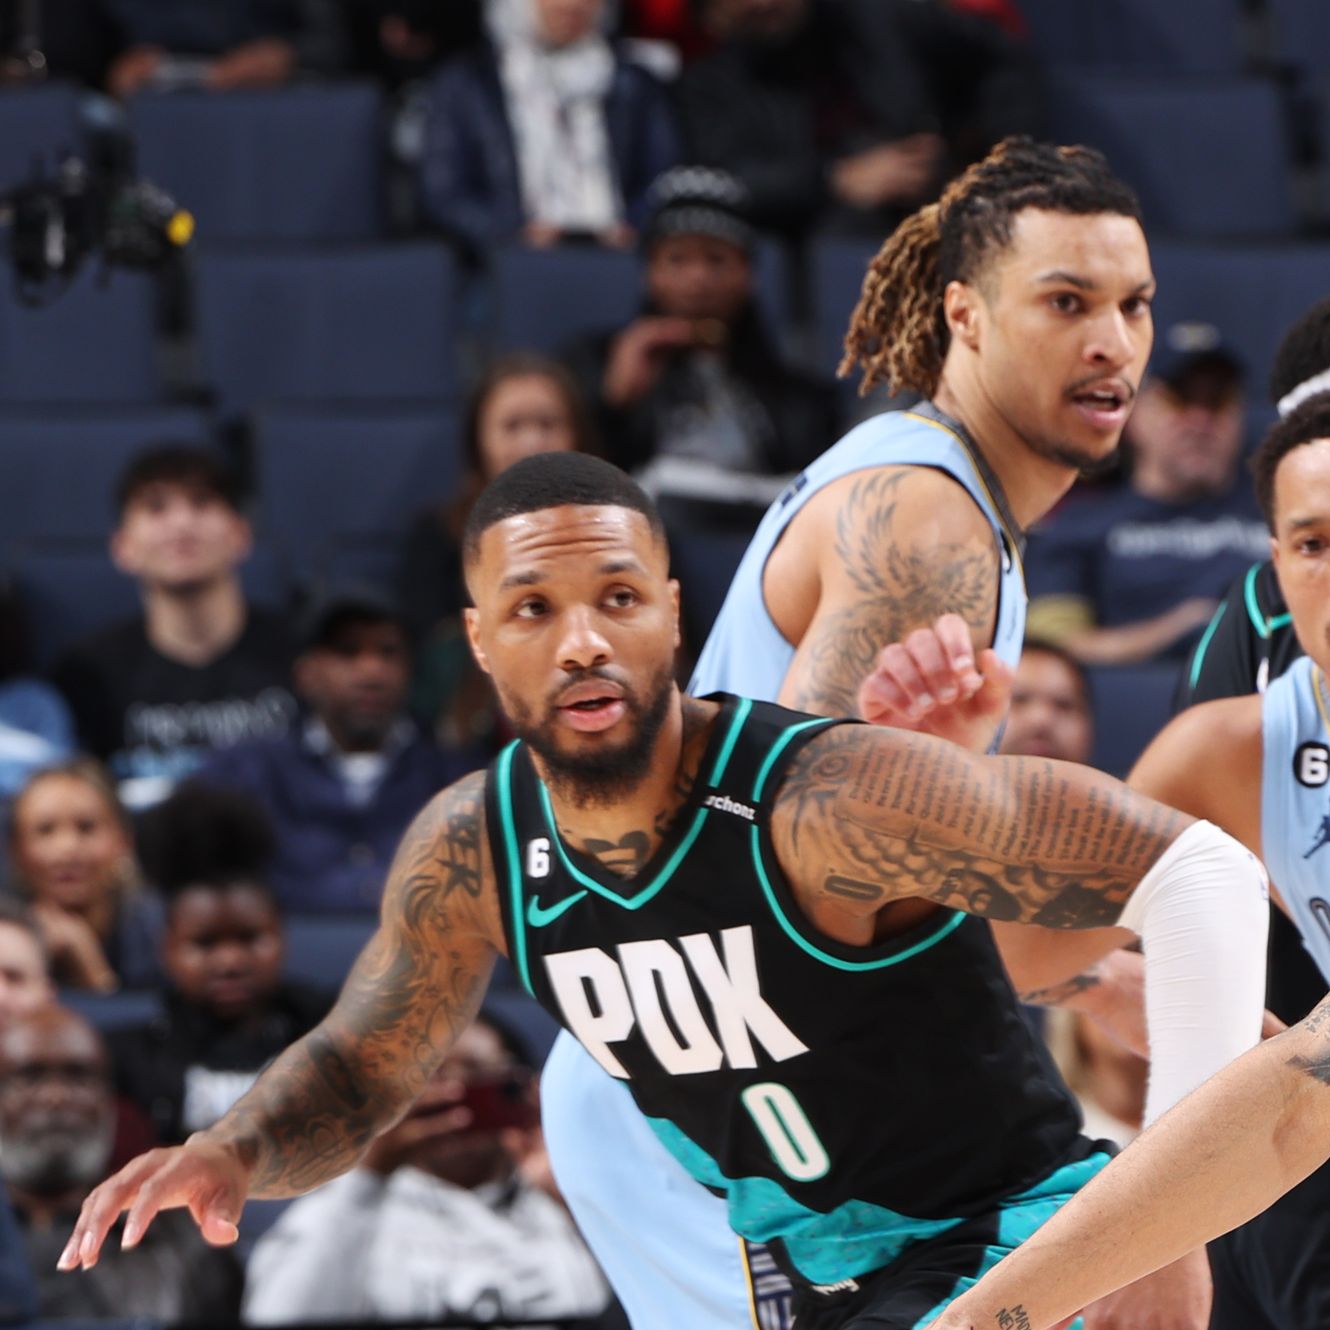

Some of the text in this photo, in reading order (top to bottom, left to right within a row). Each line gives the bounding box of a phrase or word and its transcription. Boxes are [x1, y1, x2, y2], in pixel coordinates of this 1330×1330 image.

[1301, 747, 1328, 784] 6
[526, 837, 551, 878] 6
[543, 924, 811, 1081] PDX
[741, 1081, 831, 1183] 0
